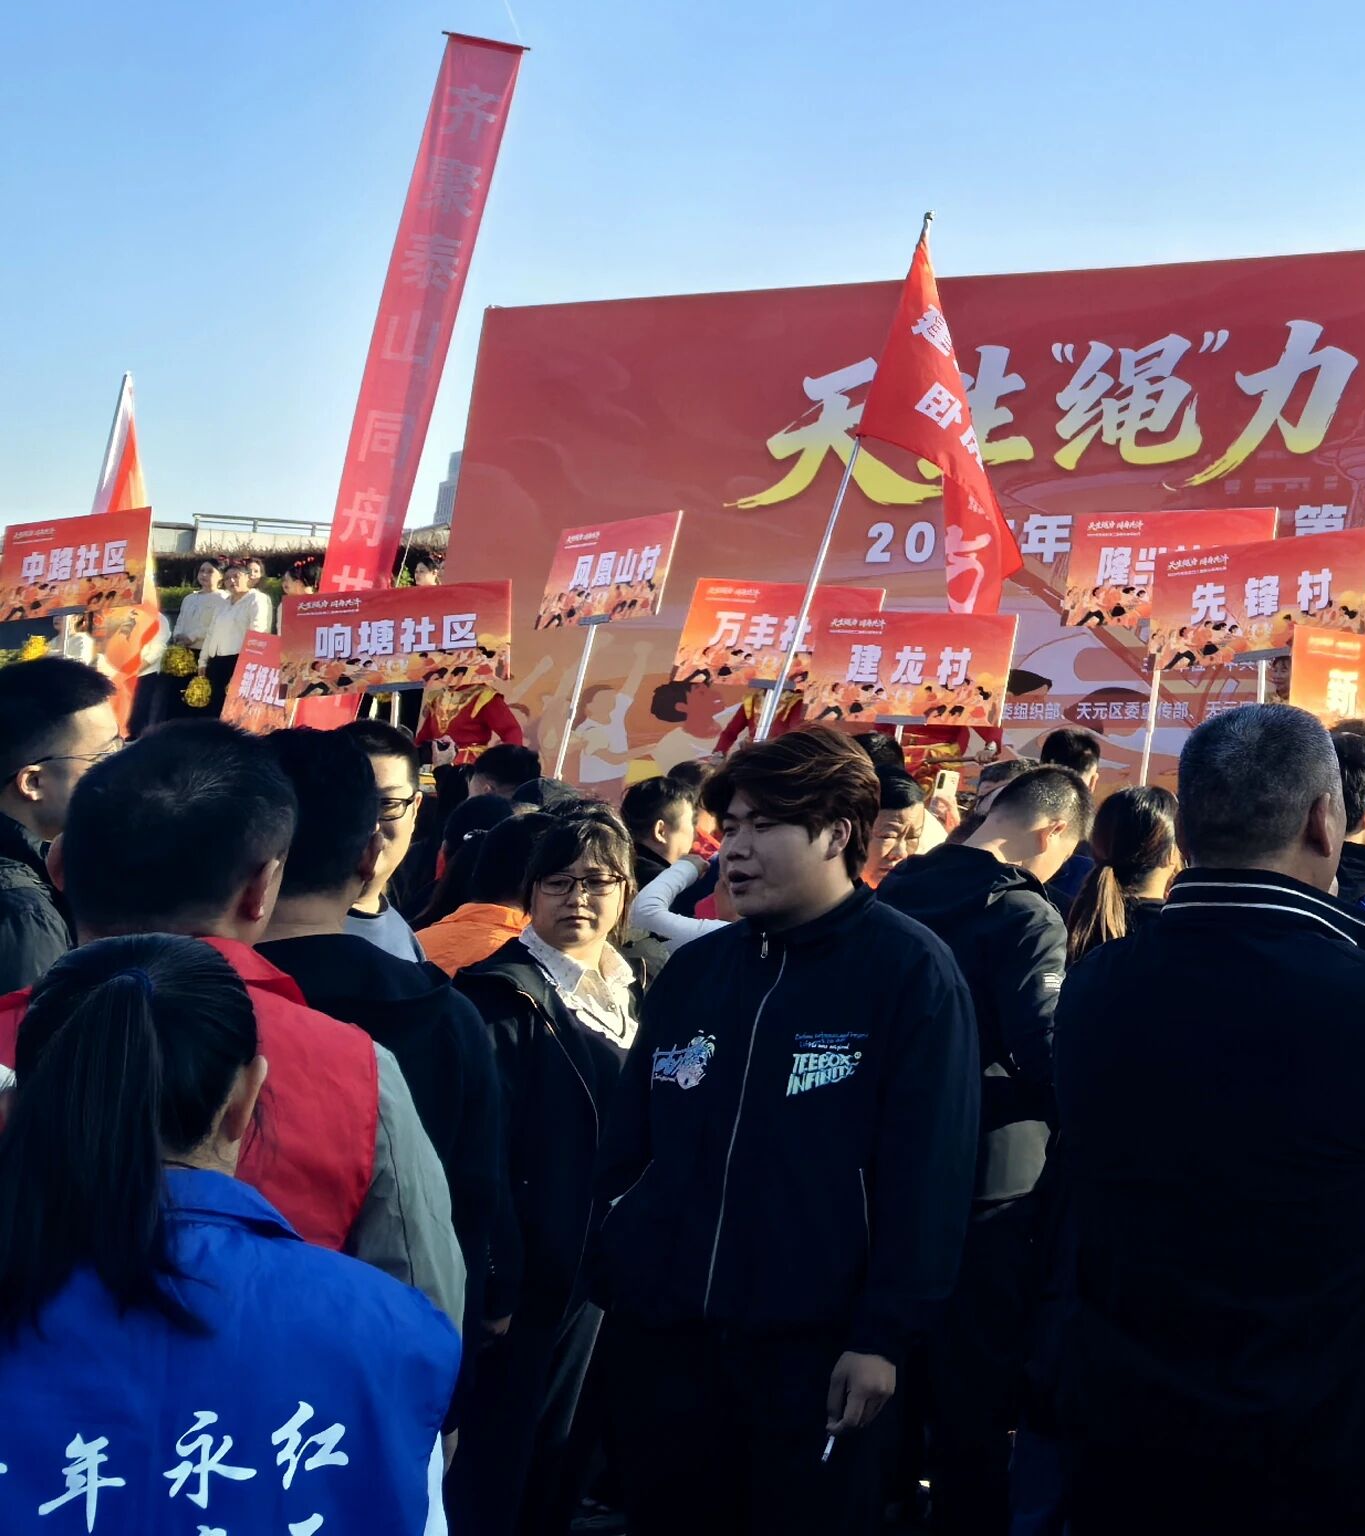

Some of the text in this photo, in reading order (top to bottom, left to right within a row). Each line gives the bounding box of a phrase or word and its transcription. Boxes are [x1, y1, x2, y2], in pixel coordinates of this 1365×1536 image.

[22, 539, 128, 584] 中路社区
[568, 544, 661, 592] 凤凰山村
[1191, 567, 1332, 624] 先锋村
[314, 613, 478, 659] 响塘社区
[708, 610, 815, 653] 万丰社
[238, 661, 285, 707] 新塘社
[847, 644, 972, 687] 建龙村
[0, 1400, 350, 1535] 年永红
